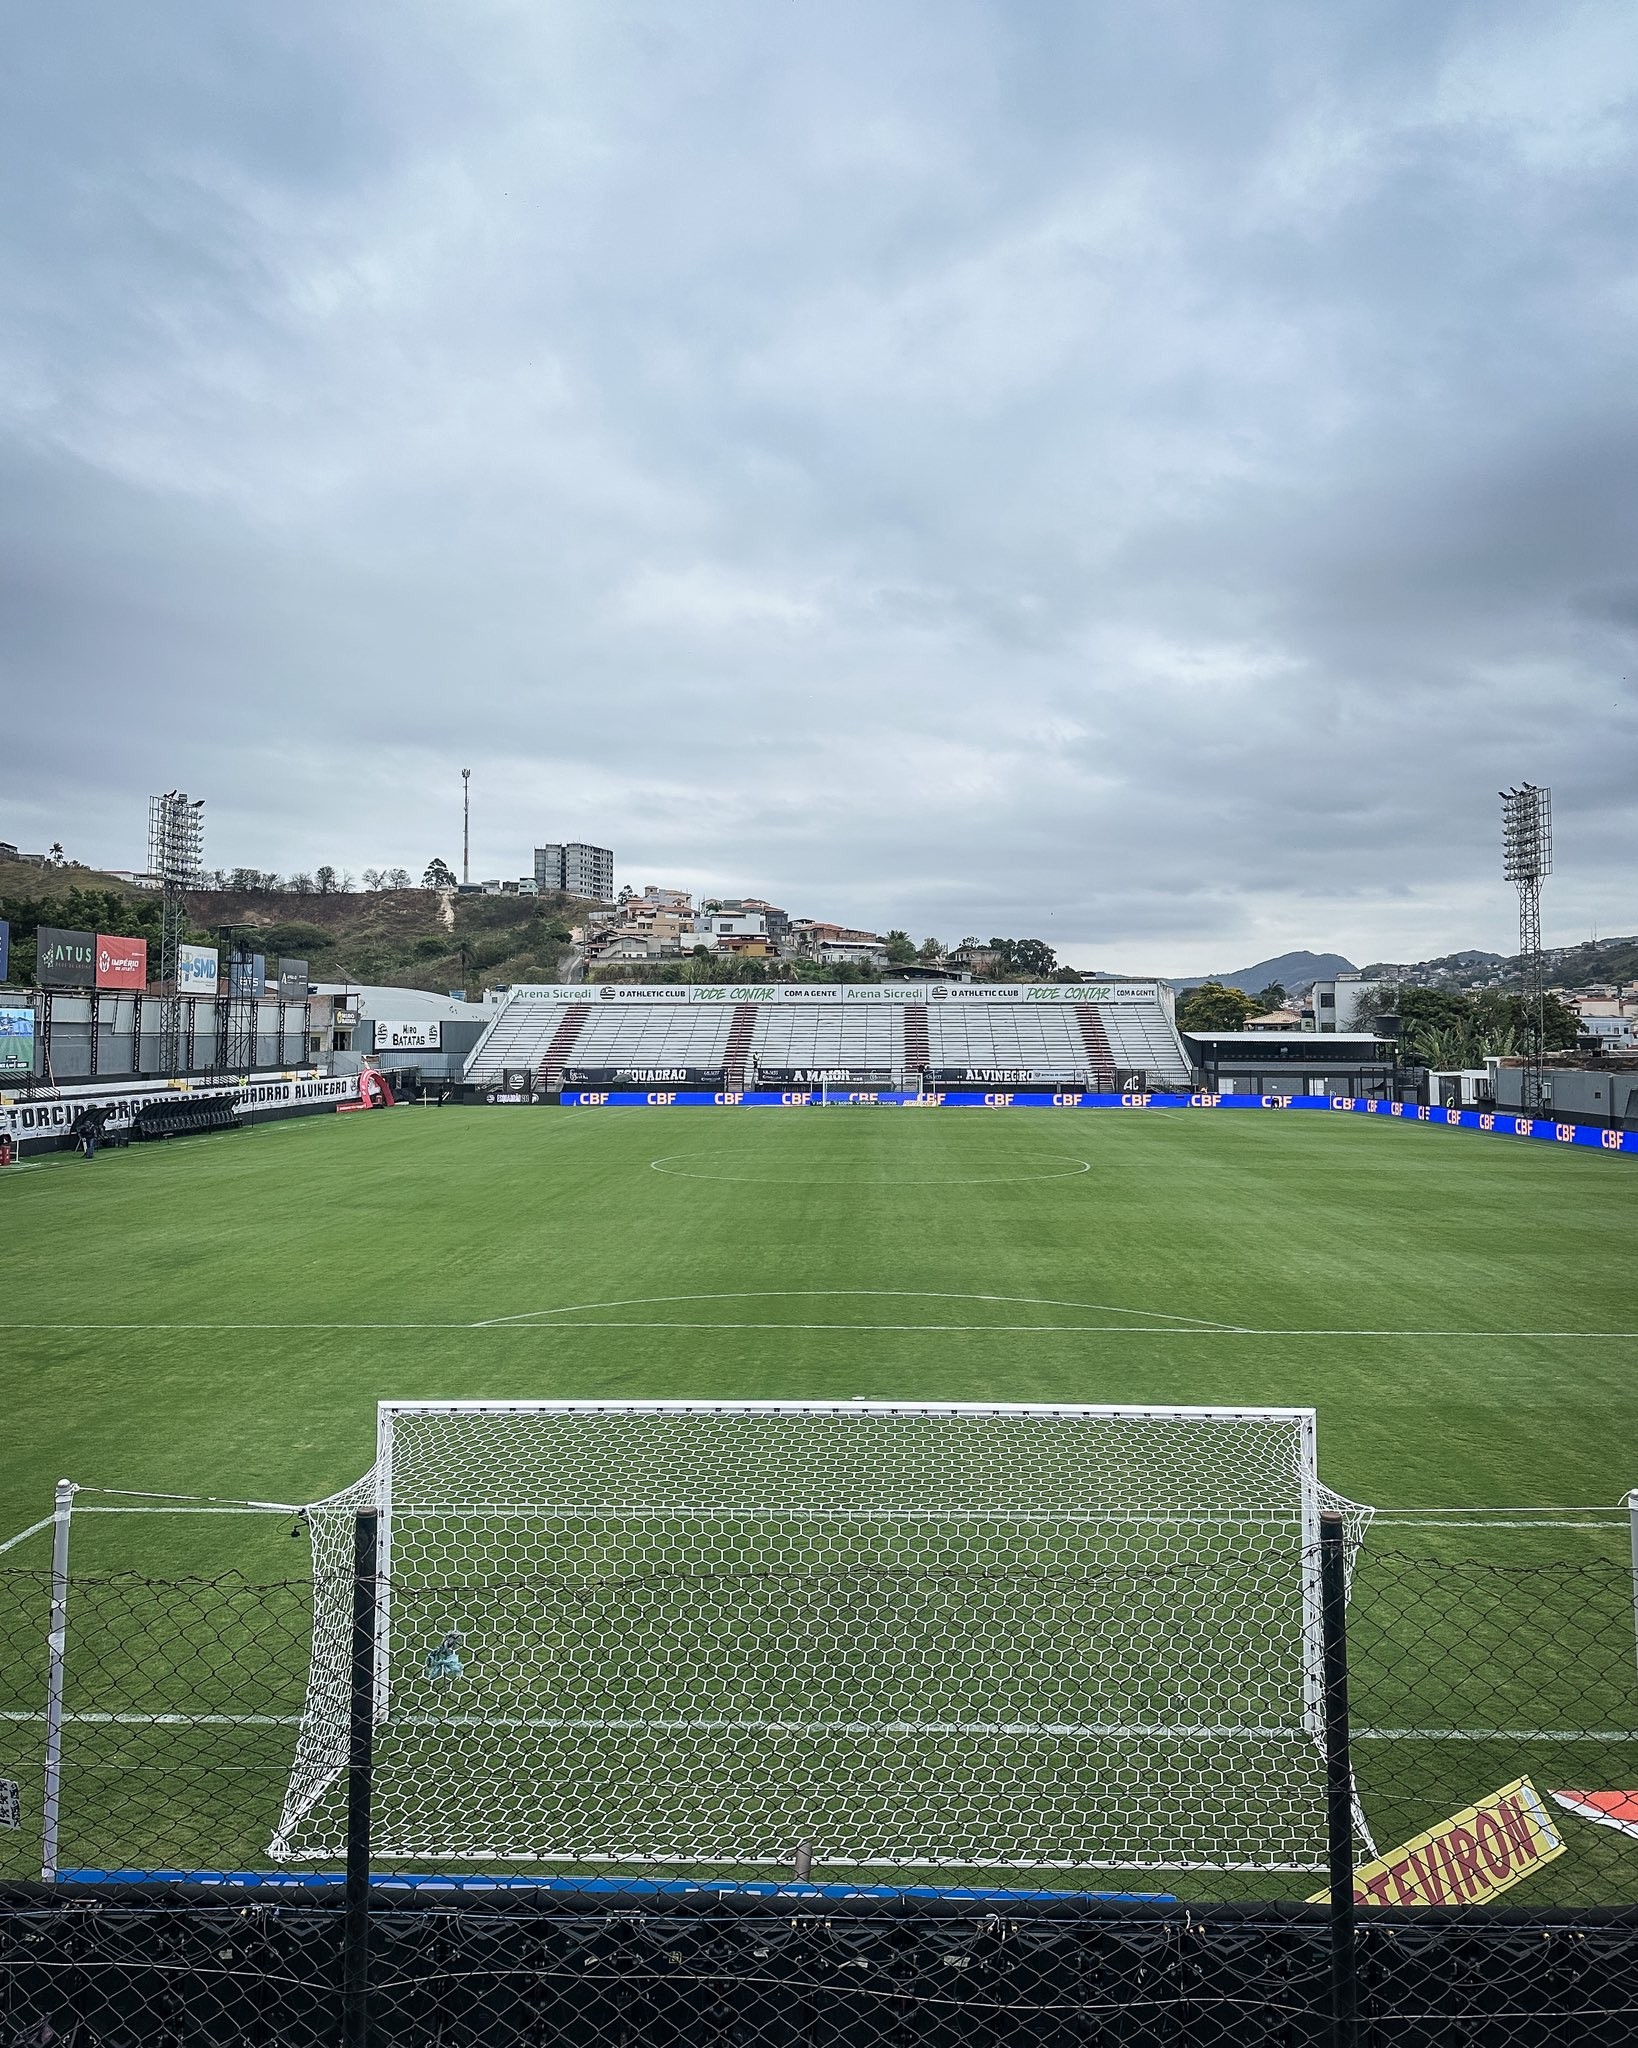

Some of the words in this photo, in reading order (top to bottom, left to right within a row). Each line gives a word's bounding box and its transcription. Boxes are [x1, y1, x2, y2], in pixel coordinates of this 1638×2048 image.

[55, 945, 92, 963] ATUS
[194, 958, 216, 979] SMD
[516, 989, 550, 999] Arena
[553, 989, 592, 999] Sicredi
[619, 990, 626, 998] O
[627, 990, 664, 998] ATHLETIC
[665, 990, 686, 998] CLUB
[693, 987, 726, 1001] PODE
[730, 987, 776, 1001] CONTAR
[847, 989, 881, 999] Arena
[884, 989, 923, 999] Sicredi
[1026, 987, 1061, 1001] PODE
[1064, 987, 1111, 1001] CONTAR
[402, 1025, 417, 1034] MIRO
[392, 1033, 426, 1046] BATATAS
[793, 1070, 806, 1081] A
[966, 1069, 1034, 1082] ALVINEGRO
[295, 1080, 347, 1099] ALVINEGRO
[1123, 1075, 1139, 1091] AC
[580, 1092, 609, 1105] CBF
[647, 1092, 677, 1105] CBF
[714, 1092, 744, 1105] CBF
[781, 1092, 811, 1105] CBF
[984, 1093, 1015, 1106] CBF
[1052, 1093, 1083, 1106] CBF
[1121, 1094, 1152, 1107] CBF
[1191, 1094, 1222, 1107] CBF
[1332, 1096, 1356, 1110] CBF
[1367, 1099, 1378, 1113] CBF
[1391, 1102, 1403, 1116] CBF
[1446, 1109, 1461, 1125] CBF
[1479, 1114, 1495, 1131] CBF
[1515, 1118, 1534, 1136] CBF
[1556, 1123, 1576, 1143] CBF
[1601, 1130, 1624, 1150] CBF
